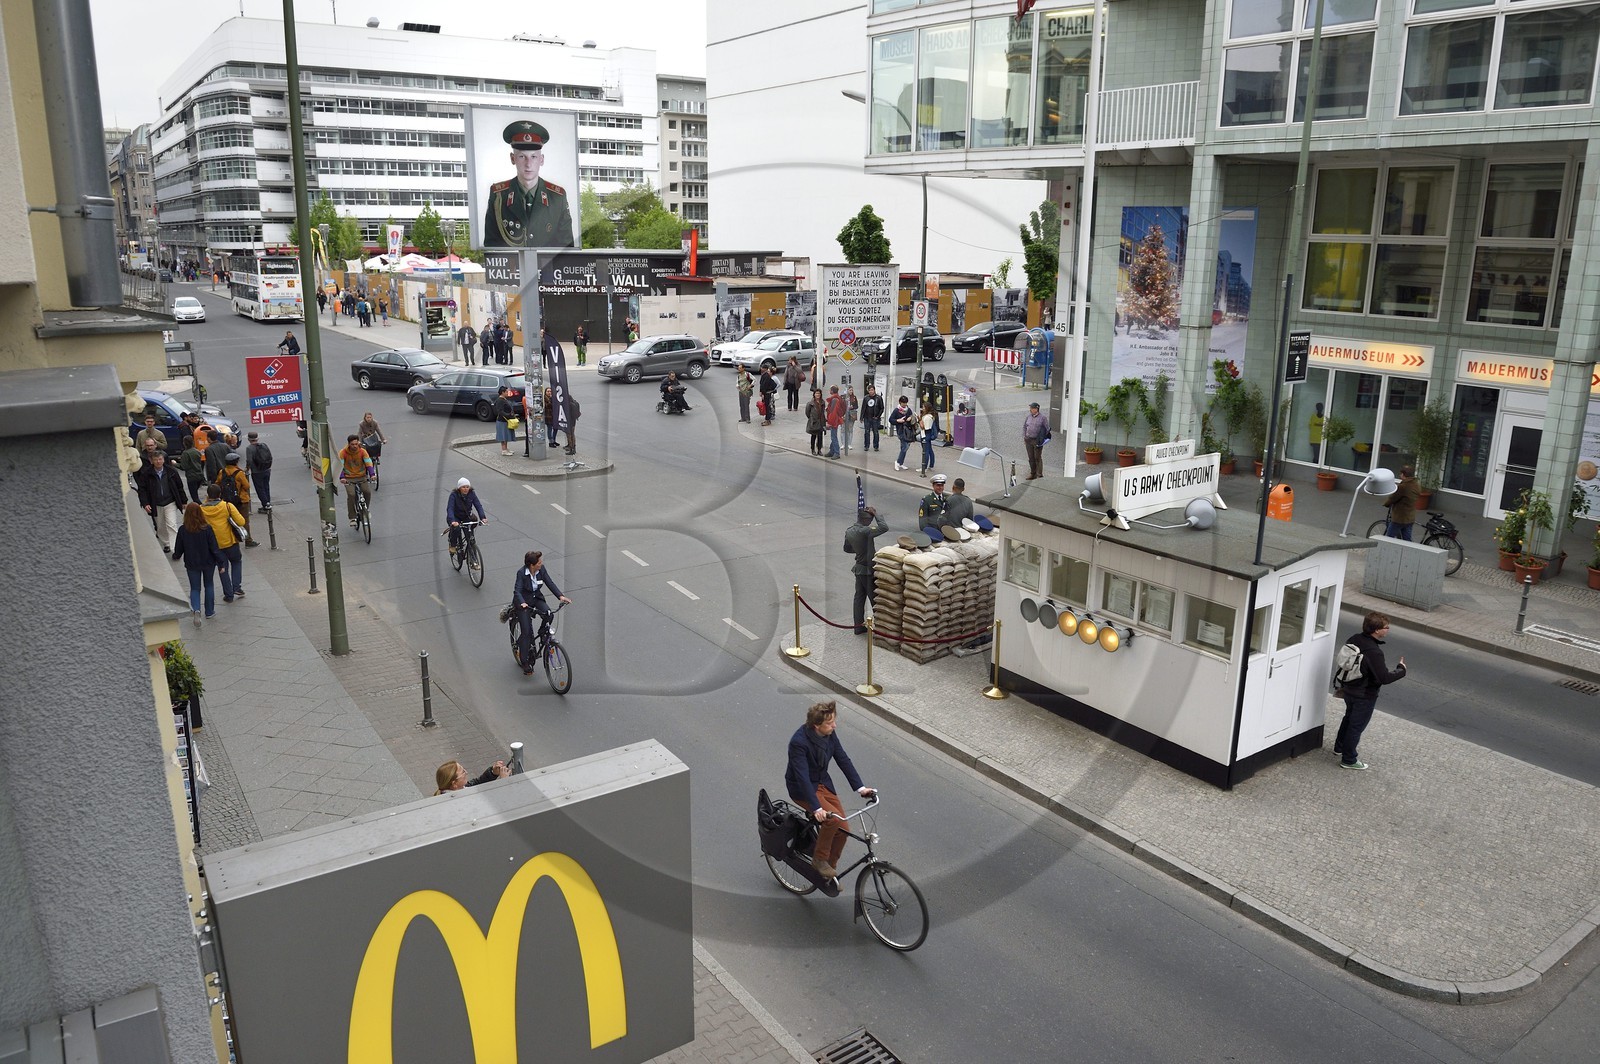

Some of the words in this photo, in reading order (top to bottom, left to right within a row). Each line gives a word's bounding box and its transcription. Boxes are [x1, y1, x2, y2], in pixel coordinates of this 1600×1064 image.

[881, 38, 914, 59] MUSEU
[926, 31, 953, 51] HAUS
[486, 258, 508, 267] МИР
[864, 270, 889, 278] LEAVING
[611, 274, 649, 287] WALL
[841, 279, 870, 287] AMERICAN
[872, 279, 892, 287] SECTOR
[538, 285, 575, 294] Checkpoint
[575, 285, 598, 293] Charlie
[829, 289, 839, 297] ВЫ
[842, 289, 879, 297] ВЫЕЗЖАЕТЕ
[827, 297, 870, 306] АМЕРИКАНСКОГО
[838, 307, 856, 315] VOUS
[858, 306, 881, 314] SORTEZ
[917, 306, 925, 315] 30
[827, 316, 836, 324] DU
[837, 316, 861, 324] SECTEUR
[862, 315, 891, 323] AMERICAIN
[1056, 322, 1066, 333] 45
[254, 397, 269, 406] HOT
[269, 396, 277, 404] &
[277, 393, 299, 403] FRESH
[1155, 449, 1167, 459] ALLIED
[1168, 444, 1190, 458] CHECKPOINT
[1140, 473, 1165, 495] ARMY
[1166, 464, 1215, 490] CHECKPOINT
